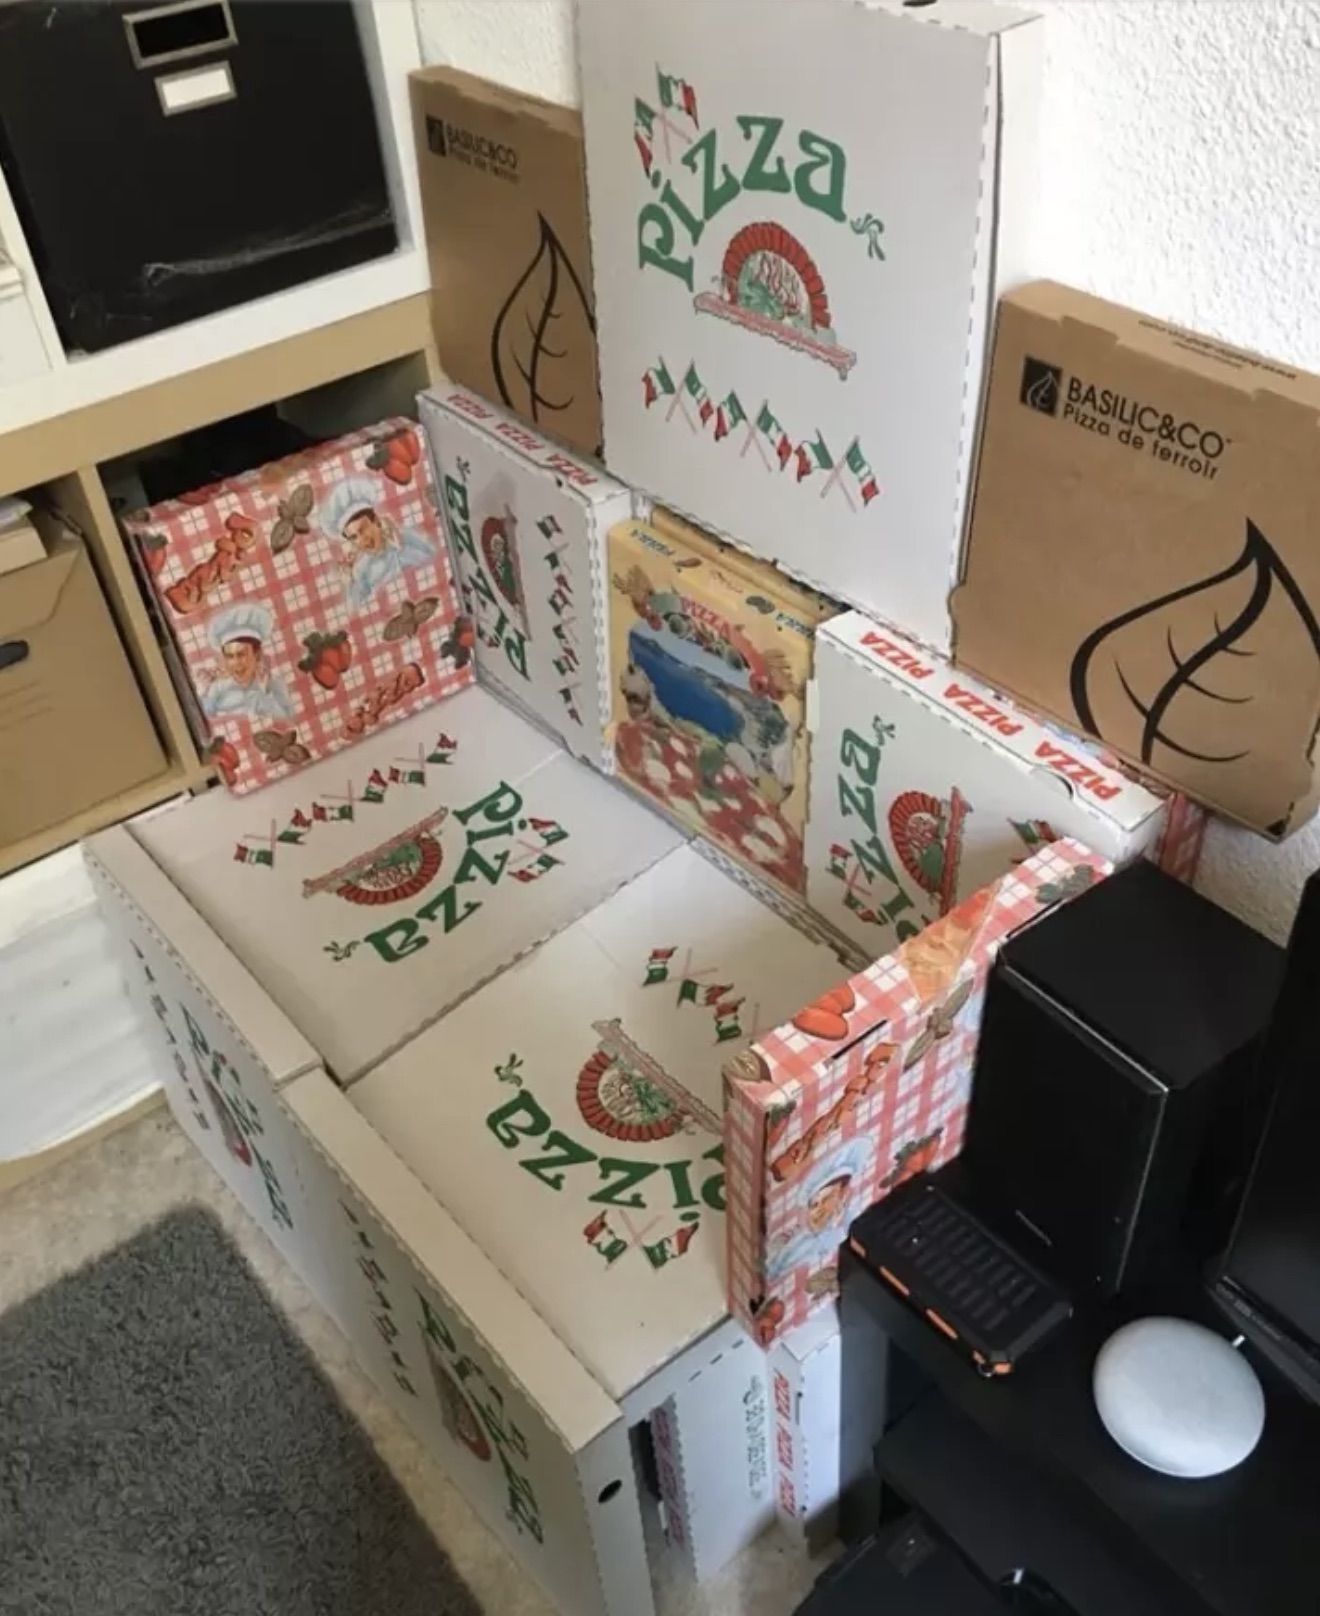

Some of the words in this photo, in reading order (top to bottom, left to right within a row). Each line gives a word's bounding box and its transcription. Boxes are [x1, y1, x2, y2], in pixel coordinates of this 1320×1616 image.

[1063, 403, 1111, 436] Pizza
[1117, 428, 1145, 450] de
[1152, 440, 1219, 481] terroir
[859, 631, 935, 680] PIZZA
[942, 683, 1025, 737] PIZZA
[1034, 740, 1123, 801] PIZZA
